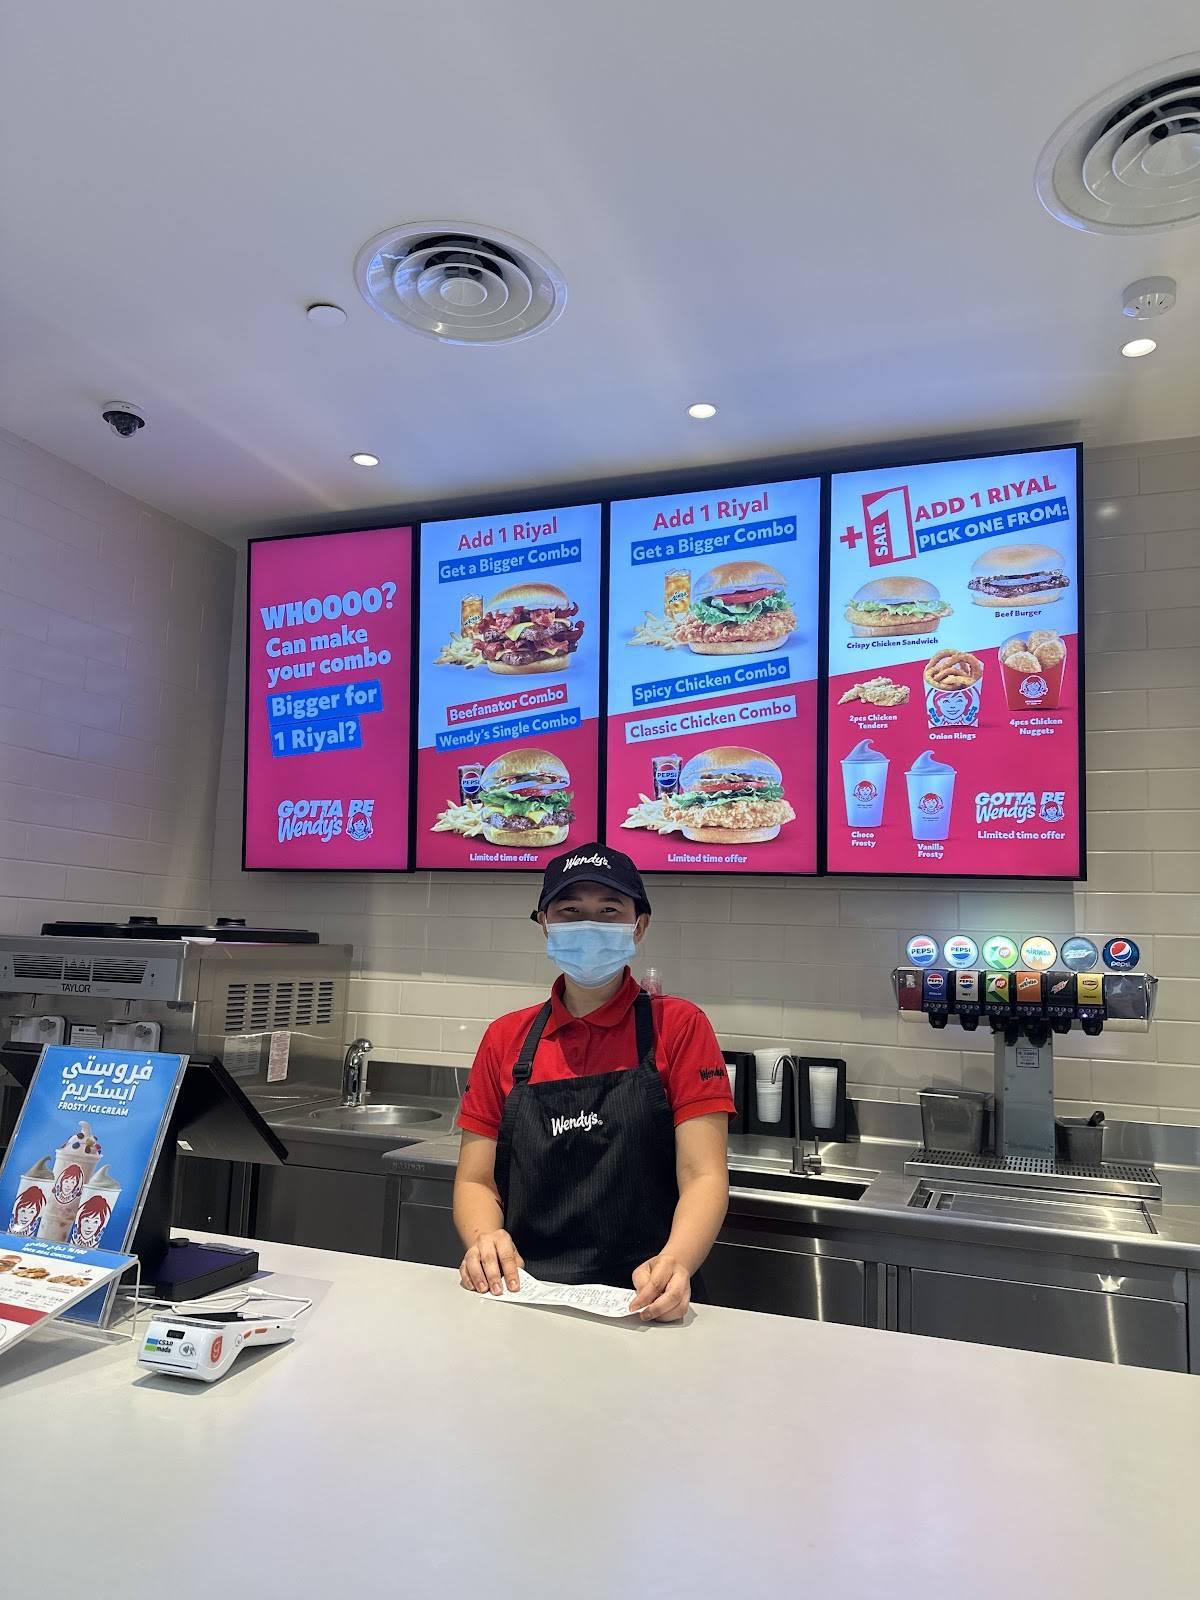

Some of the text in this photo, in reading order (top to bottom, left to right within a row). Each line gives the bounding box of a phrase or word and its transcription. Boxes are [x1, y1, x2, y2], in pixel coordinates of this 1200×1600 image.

[915, 475, 1057, 523] ADD 1 RIYAL
[653, 492, 769, 531] Add 1 Riyal
[458, 516, 559, 551] Add 1 Riyal
[919, 504, 1067, 549] PICK ONE FROM:
[632, 521, 795, 562] Get a Bigger Combo
[875, 522, 889, 557] SAR
[440, 544, 580, 579] Get a Bigger Combo
[260, 581, 397, 631] WHOOOO?
[995, 609, 1042, 619] Beef Burger
[265, 626, 368, 658] Can make
[846, 637, 938, 650] Crispy Chicken Sandwich
[266, 648, 392, 689] your combo
[634, 662, 787, 705] Spicy Chicken Combo
[271, 684, 378, 719] Bigger for
[449, 689, 565, 722] Beefanator Combo
[630, 702, 791, 740] Classic Chicken Combo
[849, 713, 898, 723] 2pcs Chicken
[859, 722, 888, 730] Tenders
[1009, 717, 1063, 727] 4pcs Chicken
[274, 722, 357, 753] 1 Riyal?
[439, 714, 578, 748] Wendy's Single Combo
[929, 732, 976, 741] Onion Rings
[1019, 727, 1054, 736] Nuggets
[975, 792, 1066, 805] GOTTA BE
[278, 800, 375, 818] GOTTA BE
[975, 803, 1036, 824] Wendy's
[278, 815, 343, 843] Wendy's
[851, 831, 875, 839] Choco
[977, 831, 1066, 840] Limited time offer
[851, 839, 876, 848] Frosty
[917, 843, 944, 851] Vanilla
[469, 853, 539, 862] Limited time offer
[562, 852, 609, 872] Wendy's
[667, 853, 747, 863] Limited time offer
[917, 850, 944, 859] Frosty
[911, 947, 934, 955] PEPSI
[1111, 960, 1131, 968] pepsi
[61, 983, 91, 993] TAYLOR
[62, 1055, 154, 1085] فروستي
[58, 1101, 129, 1116] FROSTY ICE CREAM
[551, 1110, 599, 1136] Wendy's
